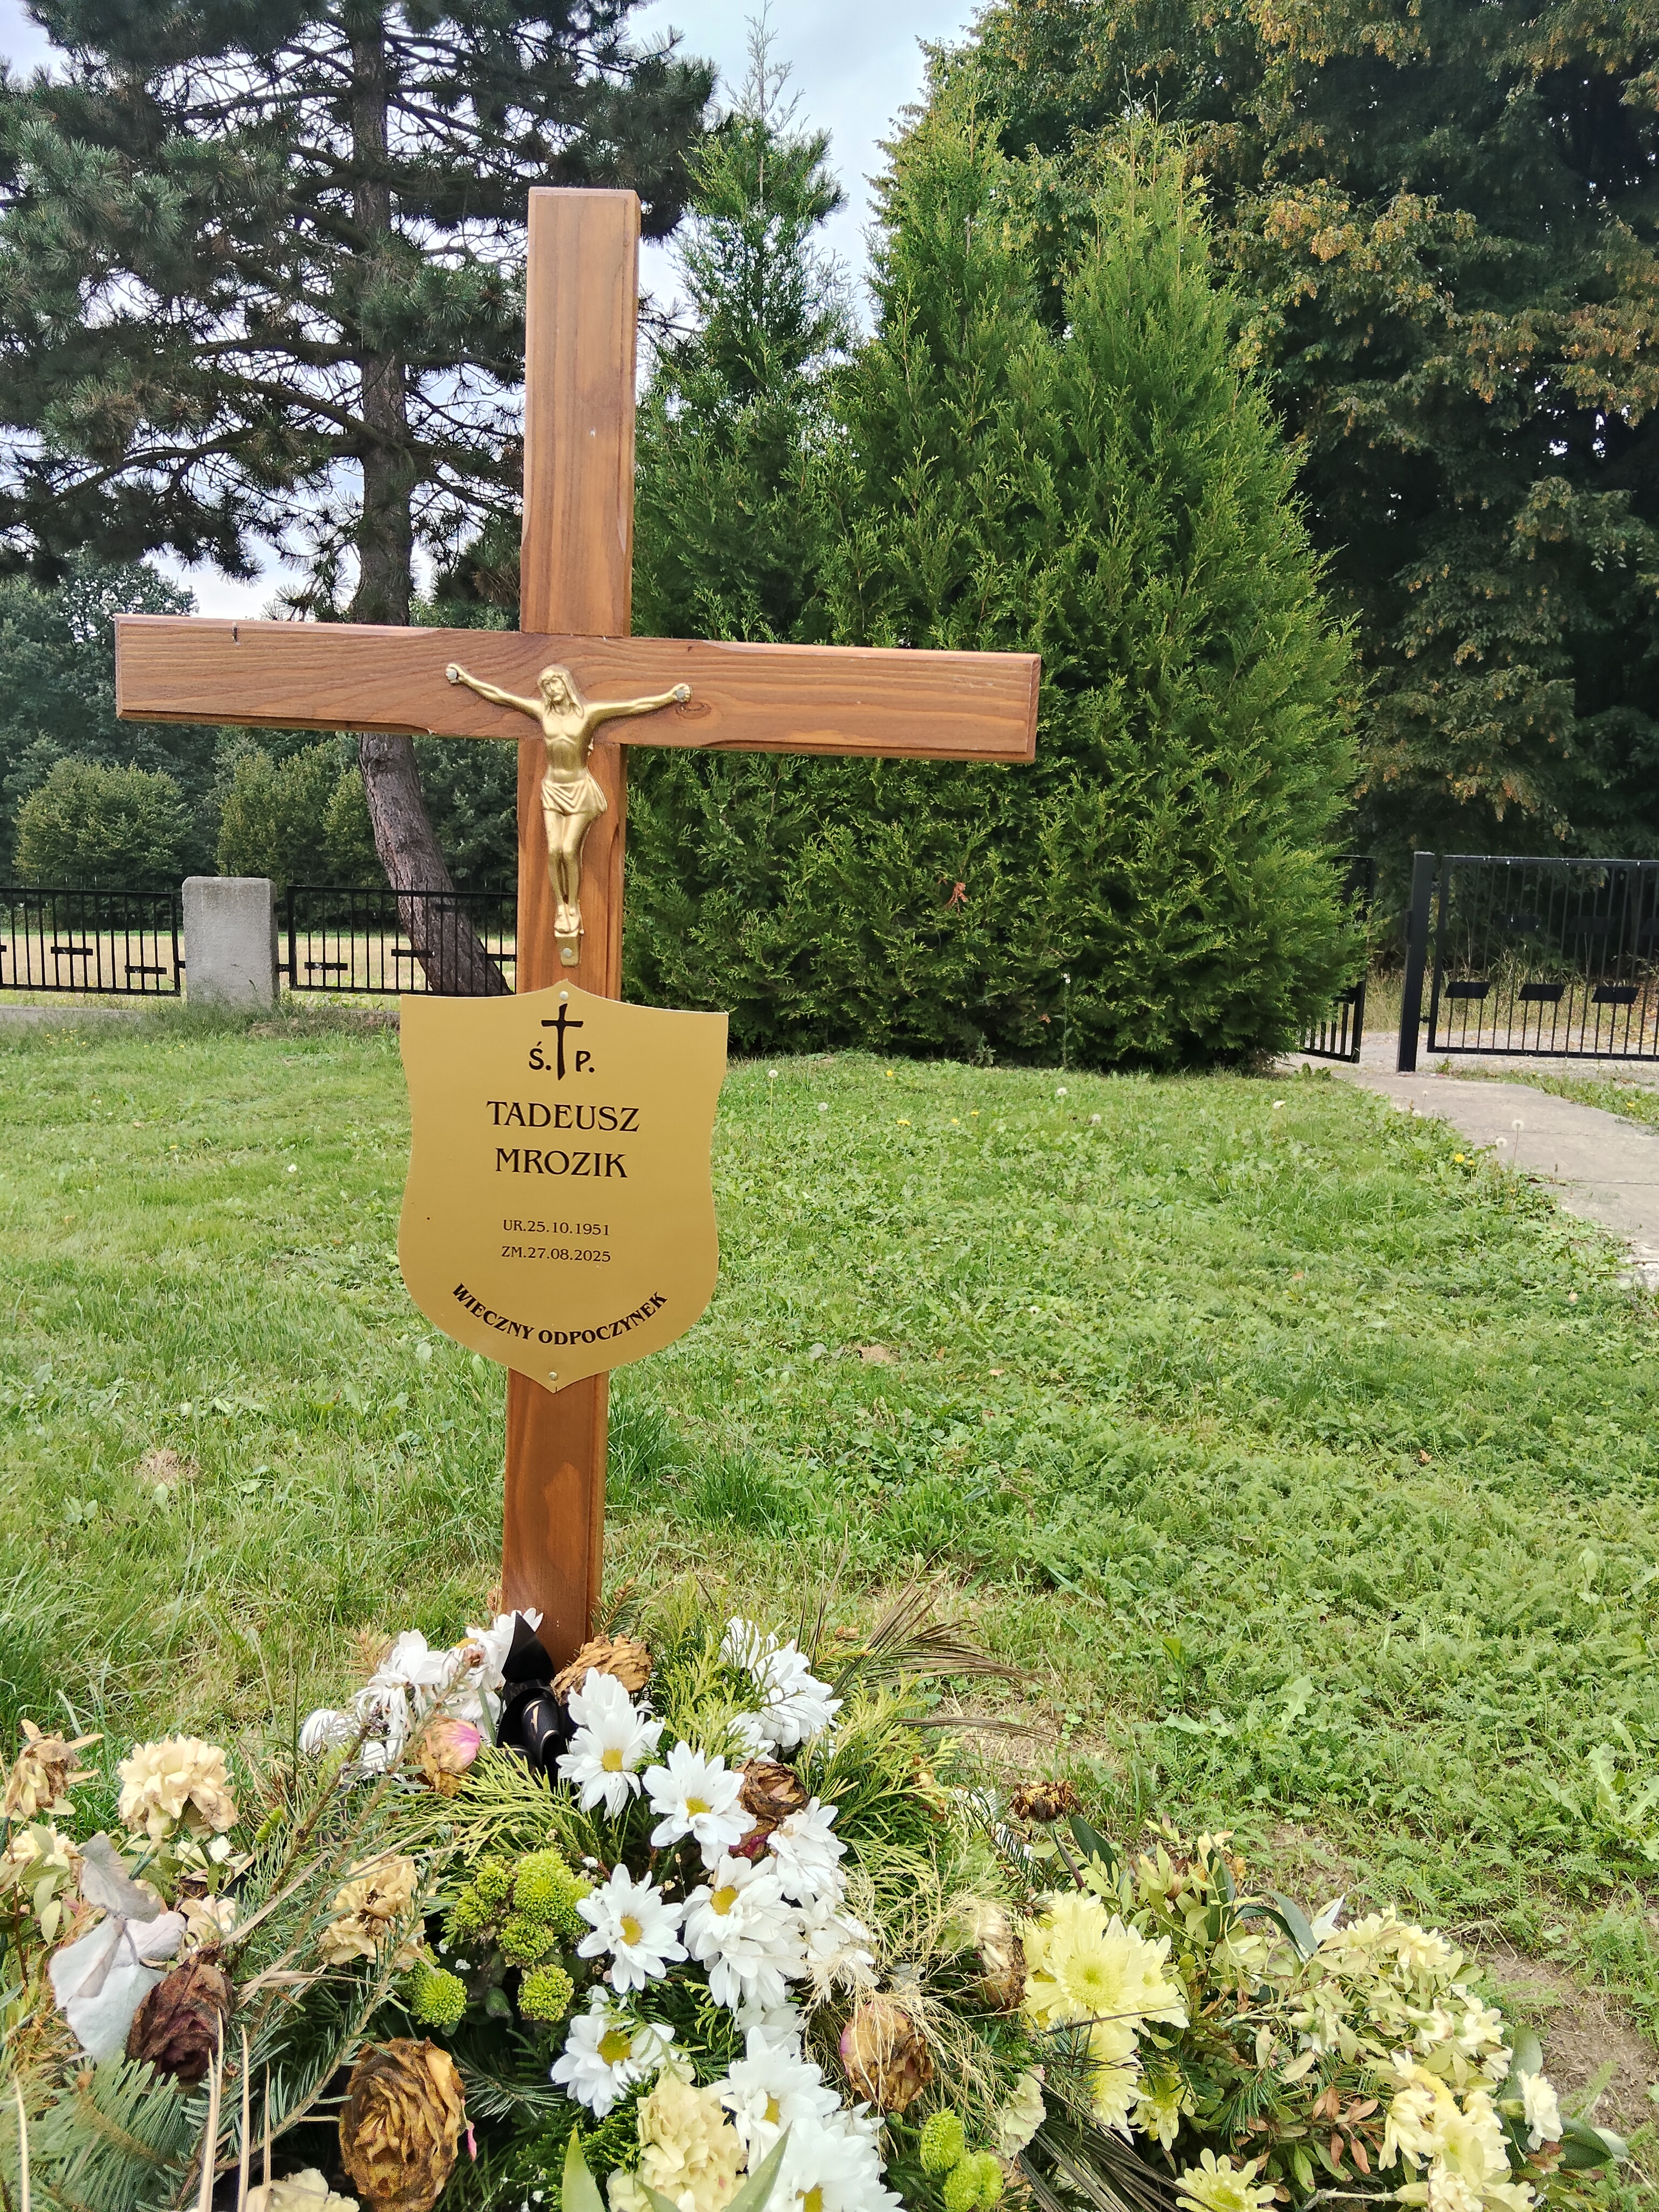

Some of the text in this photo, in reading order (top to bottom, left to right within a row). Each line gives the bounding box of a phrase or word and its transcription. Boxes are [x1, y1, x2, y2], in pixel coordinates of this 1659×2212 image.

[529, 1040, 595, 1073] Ś. P.
[486, 1100, 640, 1132] TADEUSZ
[495, 1148, 628, 1178] MROZIK
[503, 1219, 610, 1236] UR.25.10.1951
[501, 1245, 611, 1263] ZM.27.08.2025
[452, 1282, 668, 1345] WIECZNY ODPOCZYNEK
